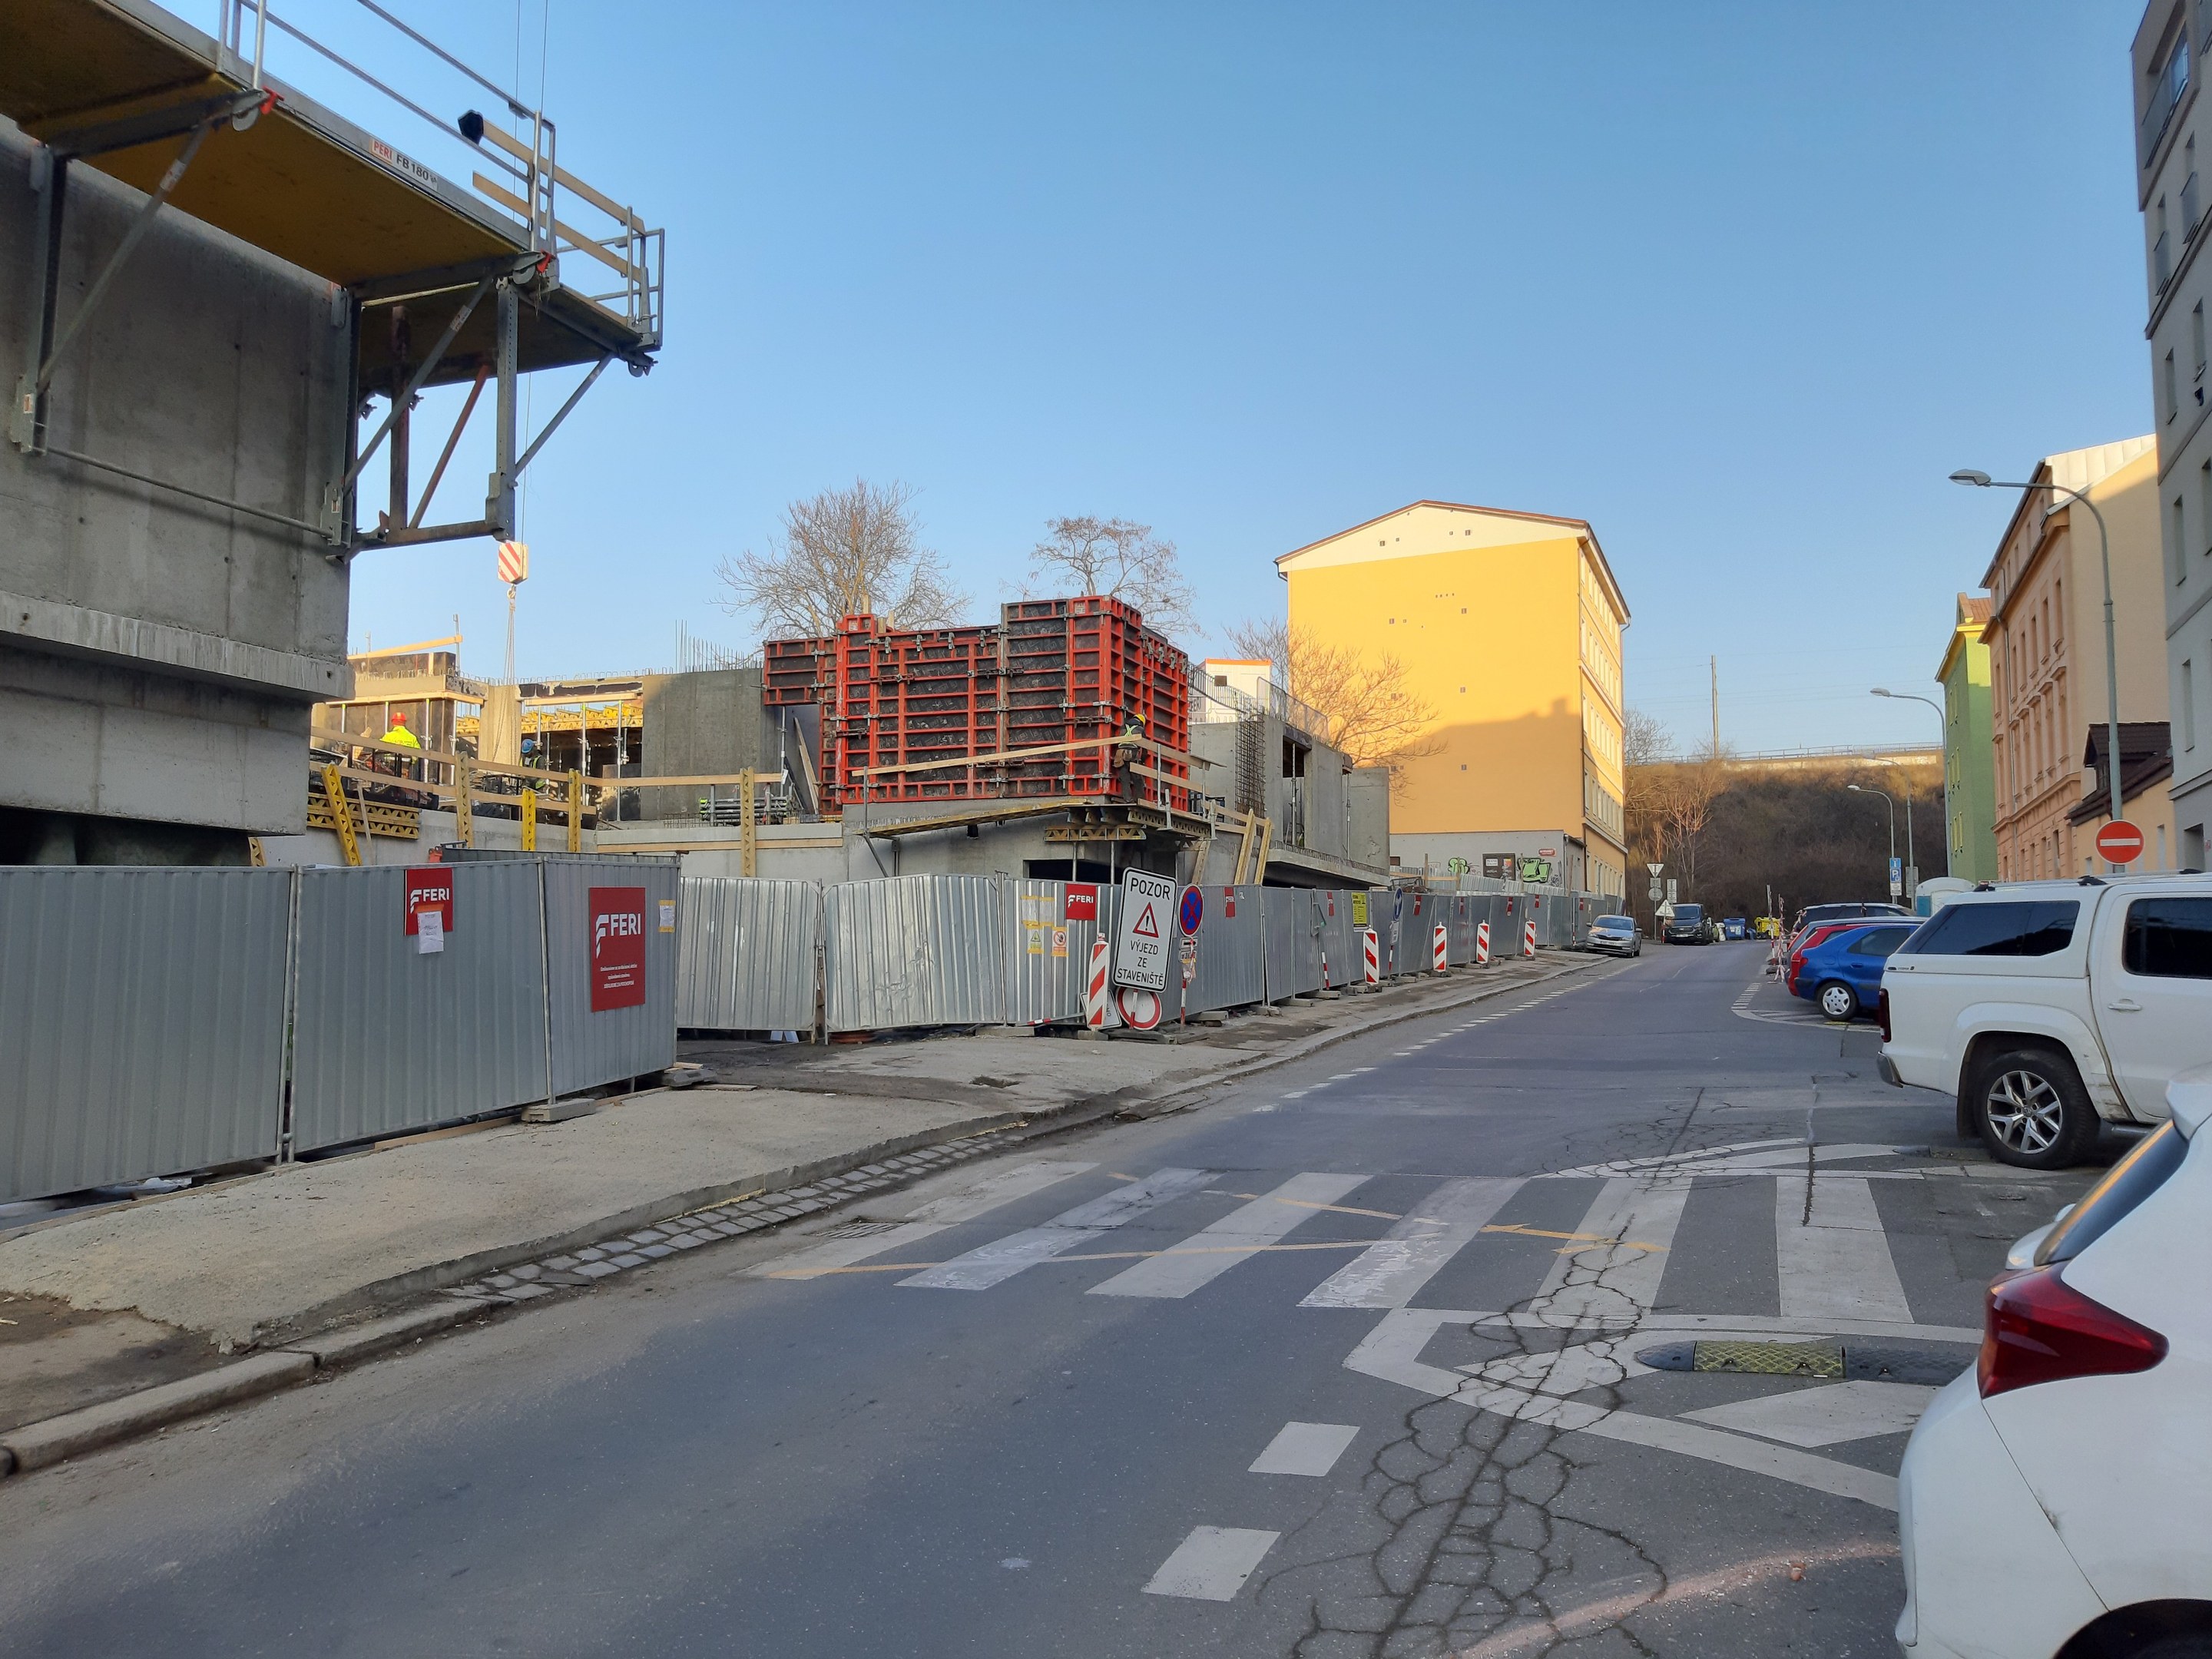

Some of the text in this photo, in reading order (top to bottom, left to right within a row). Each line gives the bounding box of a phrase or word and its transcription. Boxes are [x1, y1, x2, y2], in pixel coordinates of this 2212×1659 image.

[374, 140, 392, 160] PERI
[396, 154, 409, 170] FB
[411, 164, 429, 181] 180
[423, 888, 450, 902] FERI
[1130, 877, 1171, 901] POZOR
[1076, 895, 1094, 904] FERI
[611, 913, 641, 936] FERI
[1131, 939, 1159, 955] VÝJEZD
[1137, 956, 1147, 969] ZE
[1117, 968, 1164, 986] STAVENIŠTĚ
